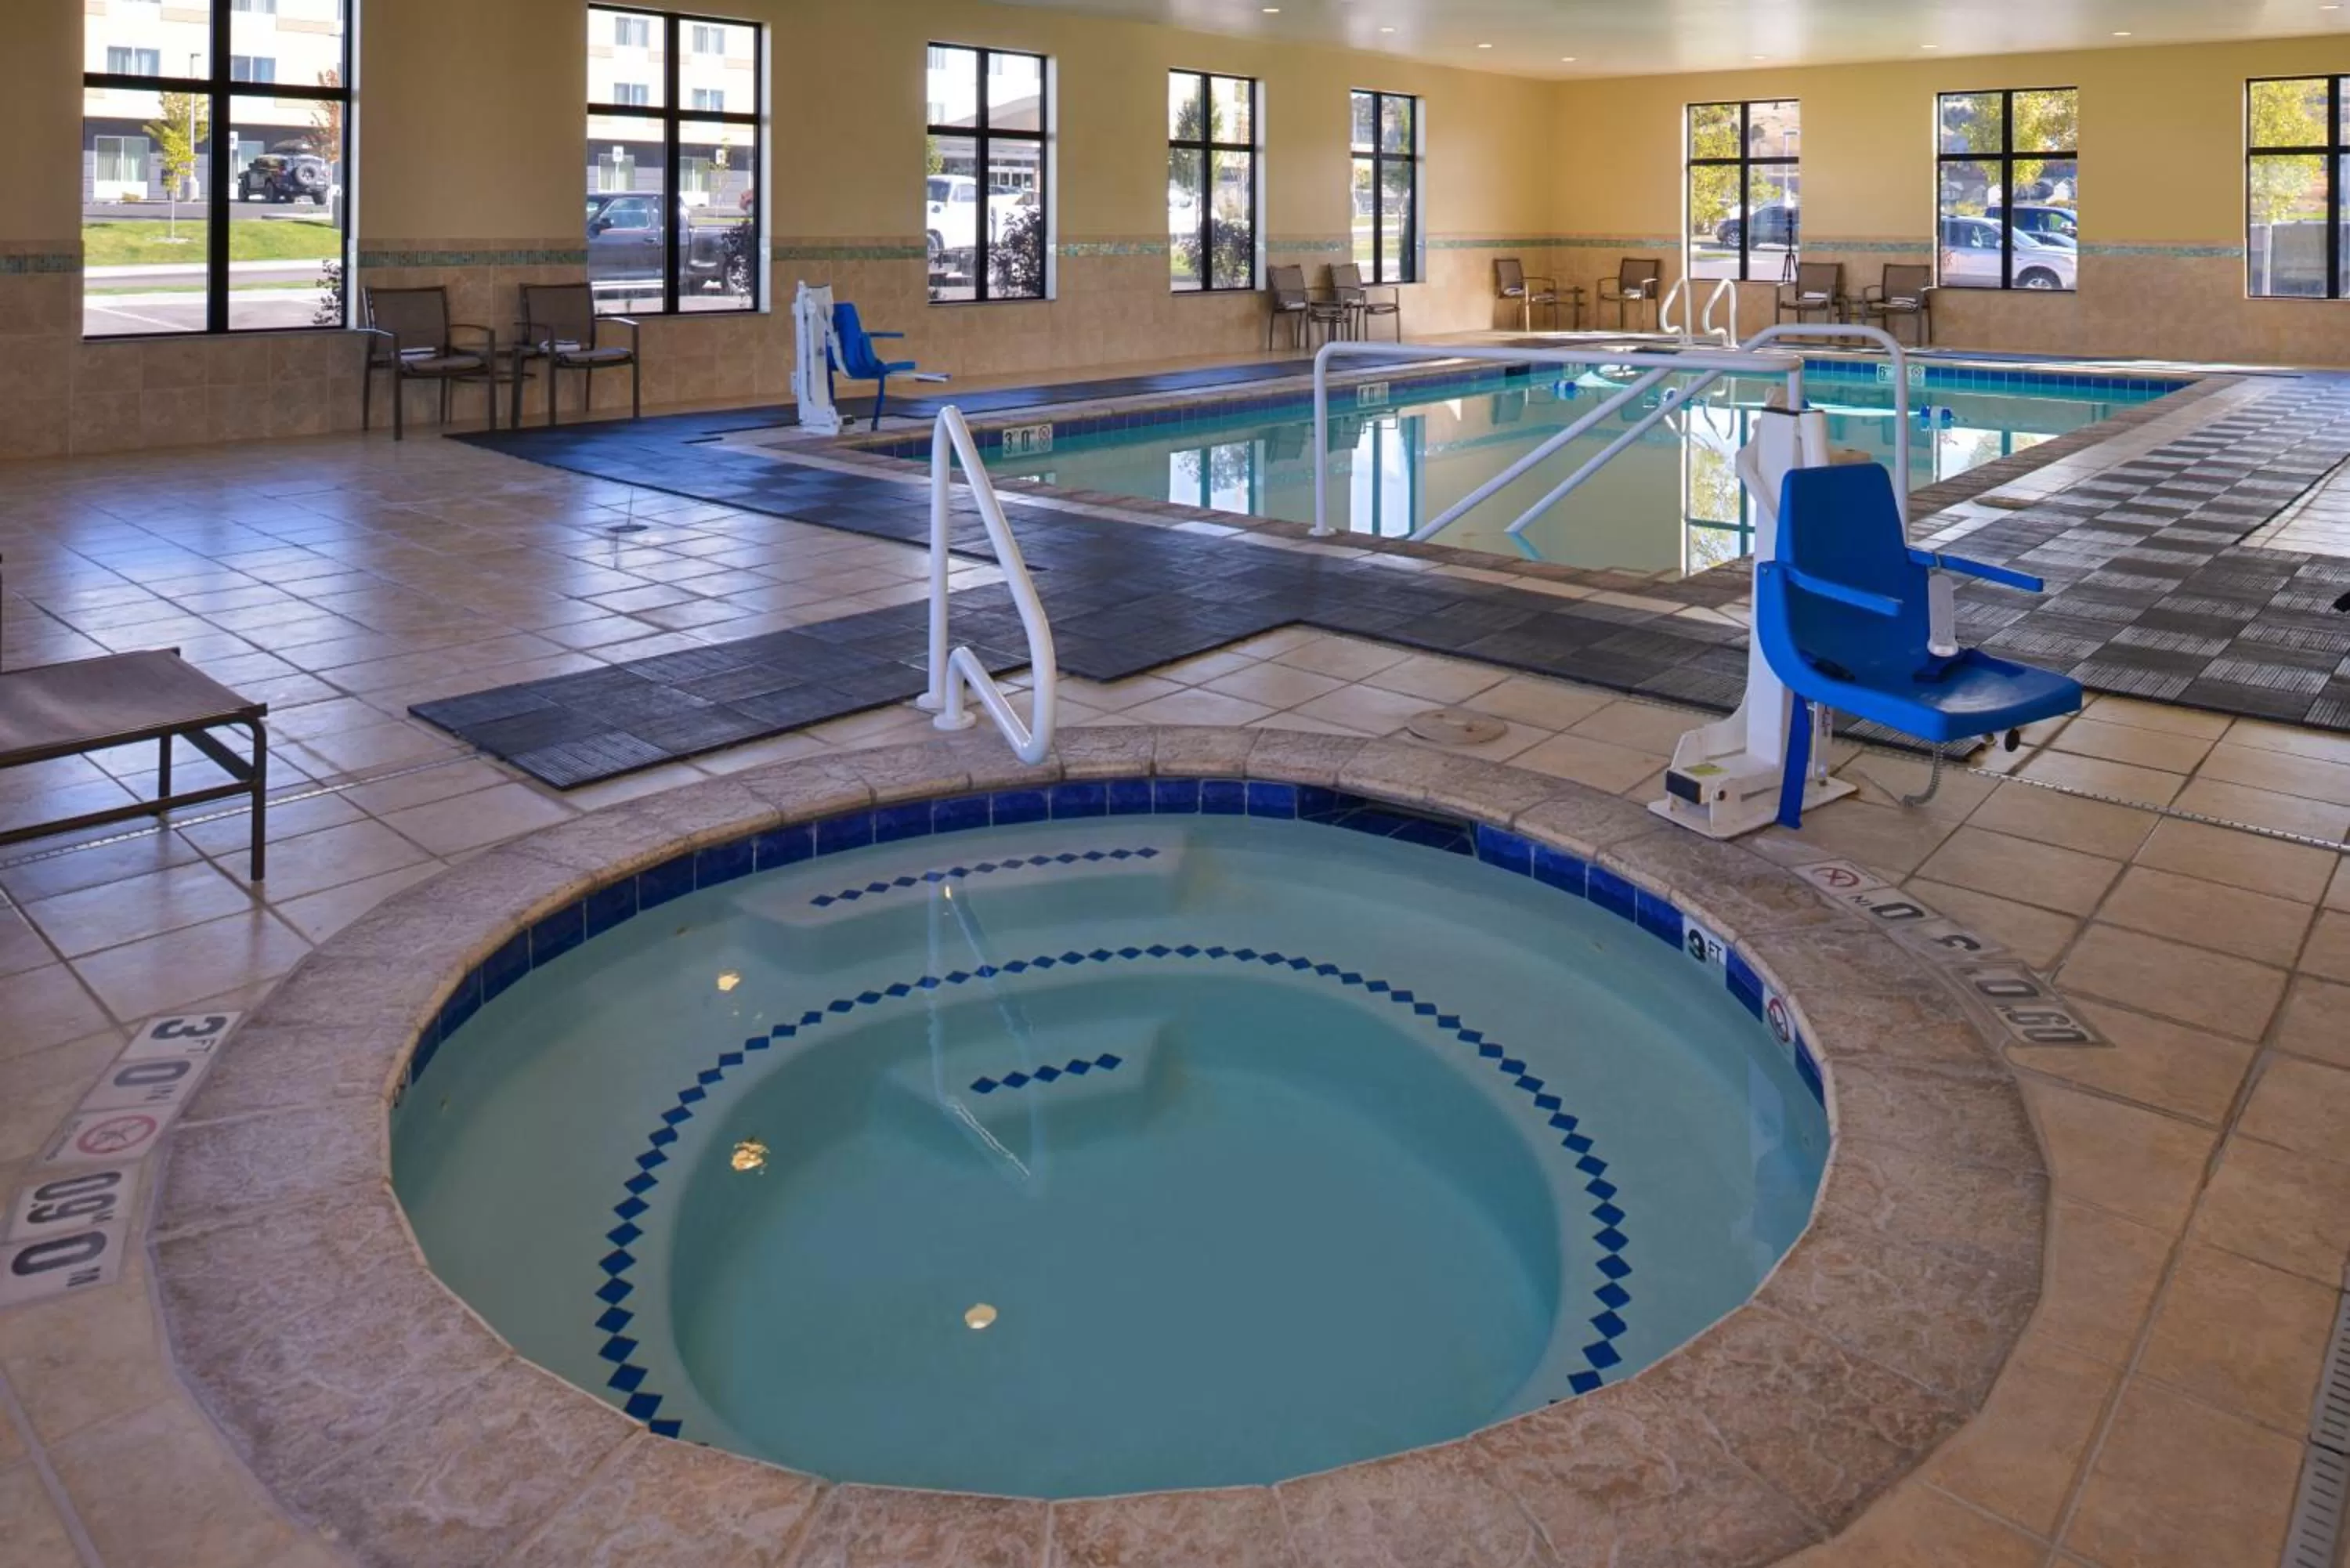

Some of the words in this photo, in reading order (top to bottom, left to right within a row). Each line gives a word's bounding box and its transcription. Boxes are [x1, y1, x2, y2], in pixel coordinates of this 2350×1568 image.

[151, 1017, 227, 1039] 3
[114, 1061, 191, 1086] 0
[13, 1232, 107, 1275] 0
